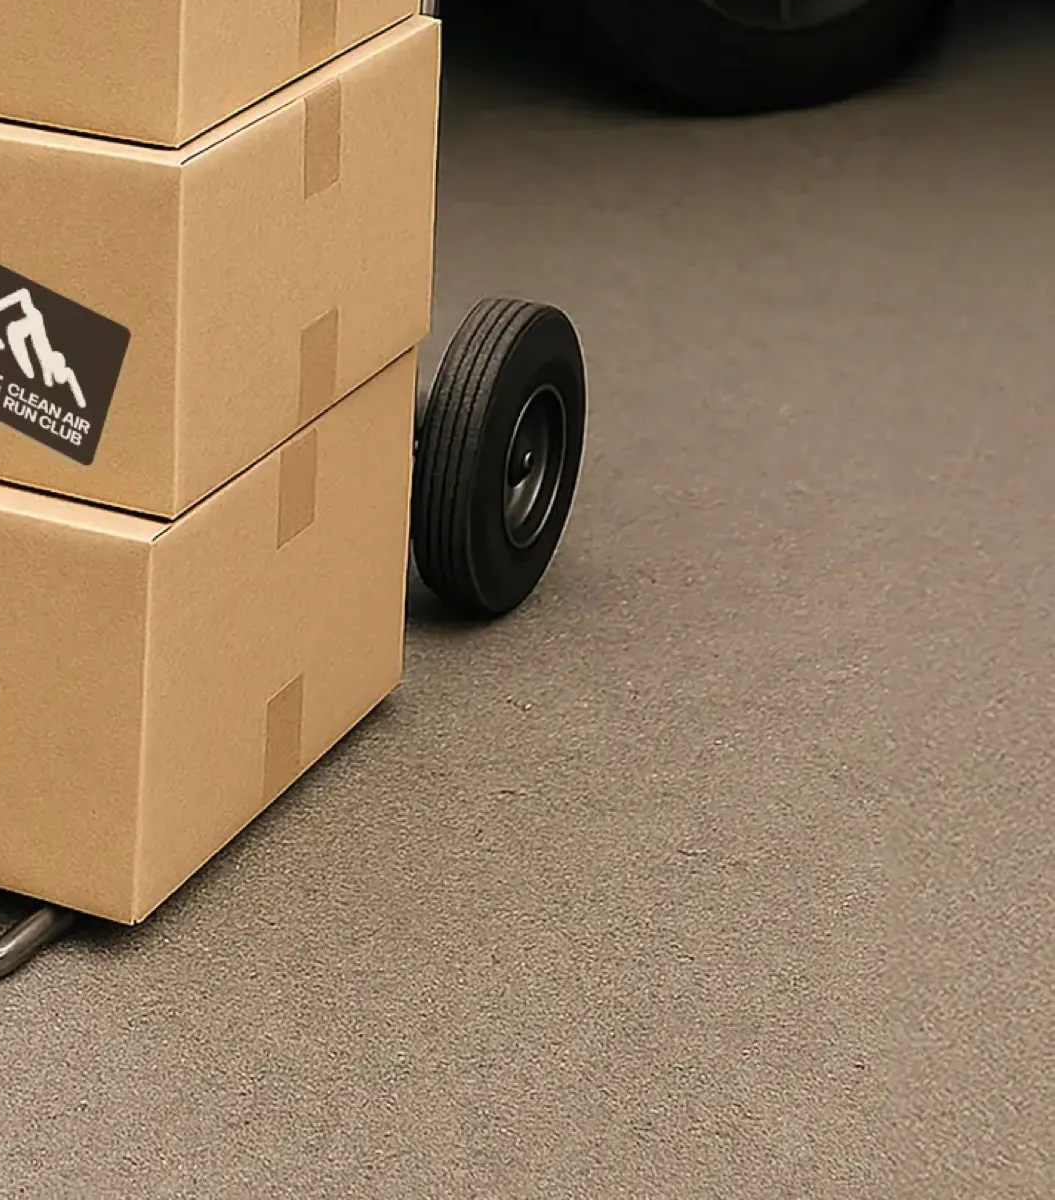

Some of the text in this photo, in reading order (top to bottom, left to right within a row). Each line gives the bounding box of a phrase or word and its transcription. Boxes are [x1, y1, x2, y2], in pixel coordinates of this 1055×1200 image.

[2, 395, 83, 447] RUN CLUB
[6, 382, 92, 435] CLEAN AIR
